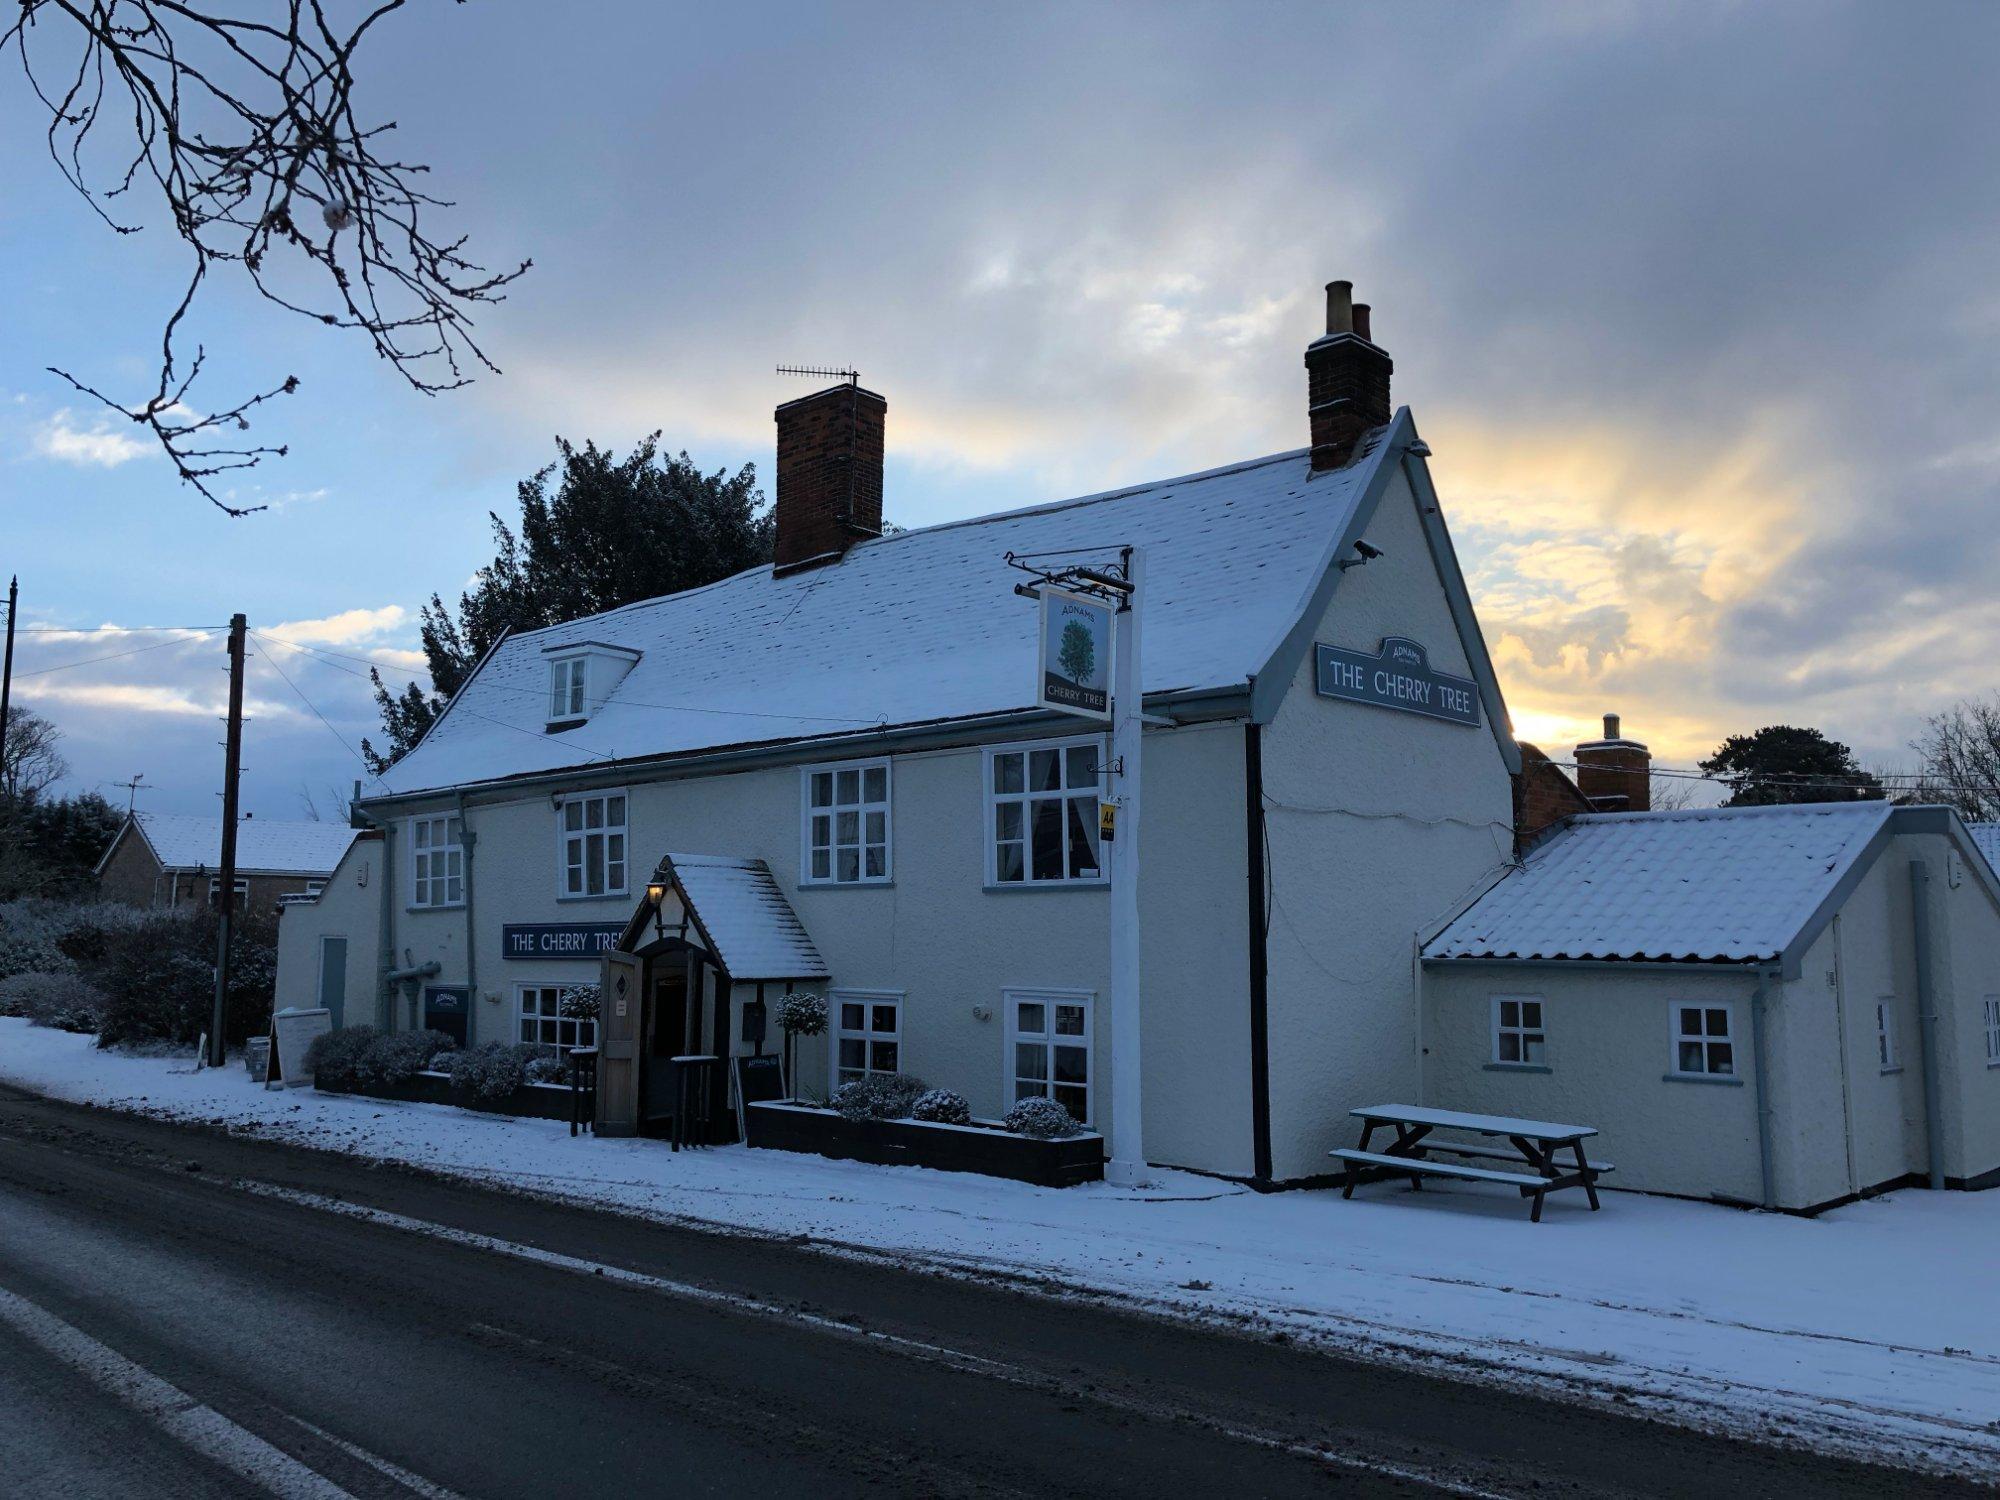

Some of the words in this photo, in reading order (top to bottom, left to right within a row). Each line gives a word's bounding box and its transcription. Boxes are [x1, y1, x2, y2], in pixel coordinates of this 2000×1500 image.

[1062, 604, 1095, 623] ADNAMS
[1392, 645, 1421, 664] ADNAMS
[1047, 684, 1080, 701] CHERRY
[1083, 692, 1104, 706] TREE
[1330, 660, 1364, 690] THE
[1374, 670, 1431, 704] CHERRY
[1438, 685, 1470, 714] TREE
[1103, 811, 1114, 824] AA
[512, 933, 535, 951] THE
[541, 933, 588, 951] CHERRY
